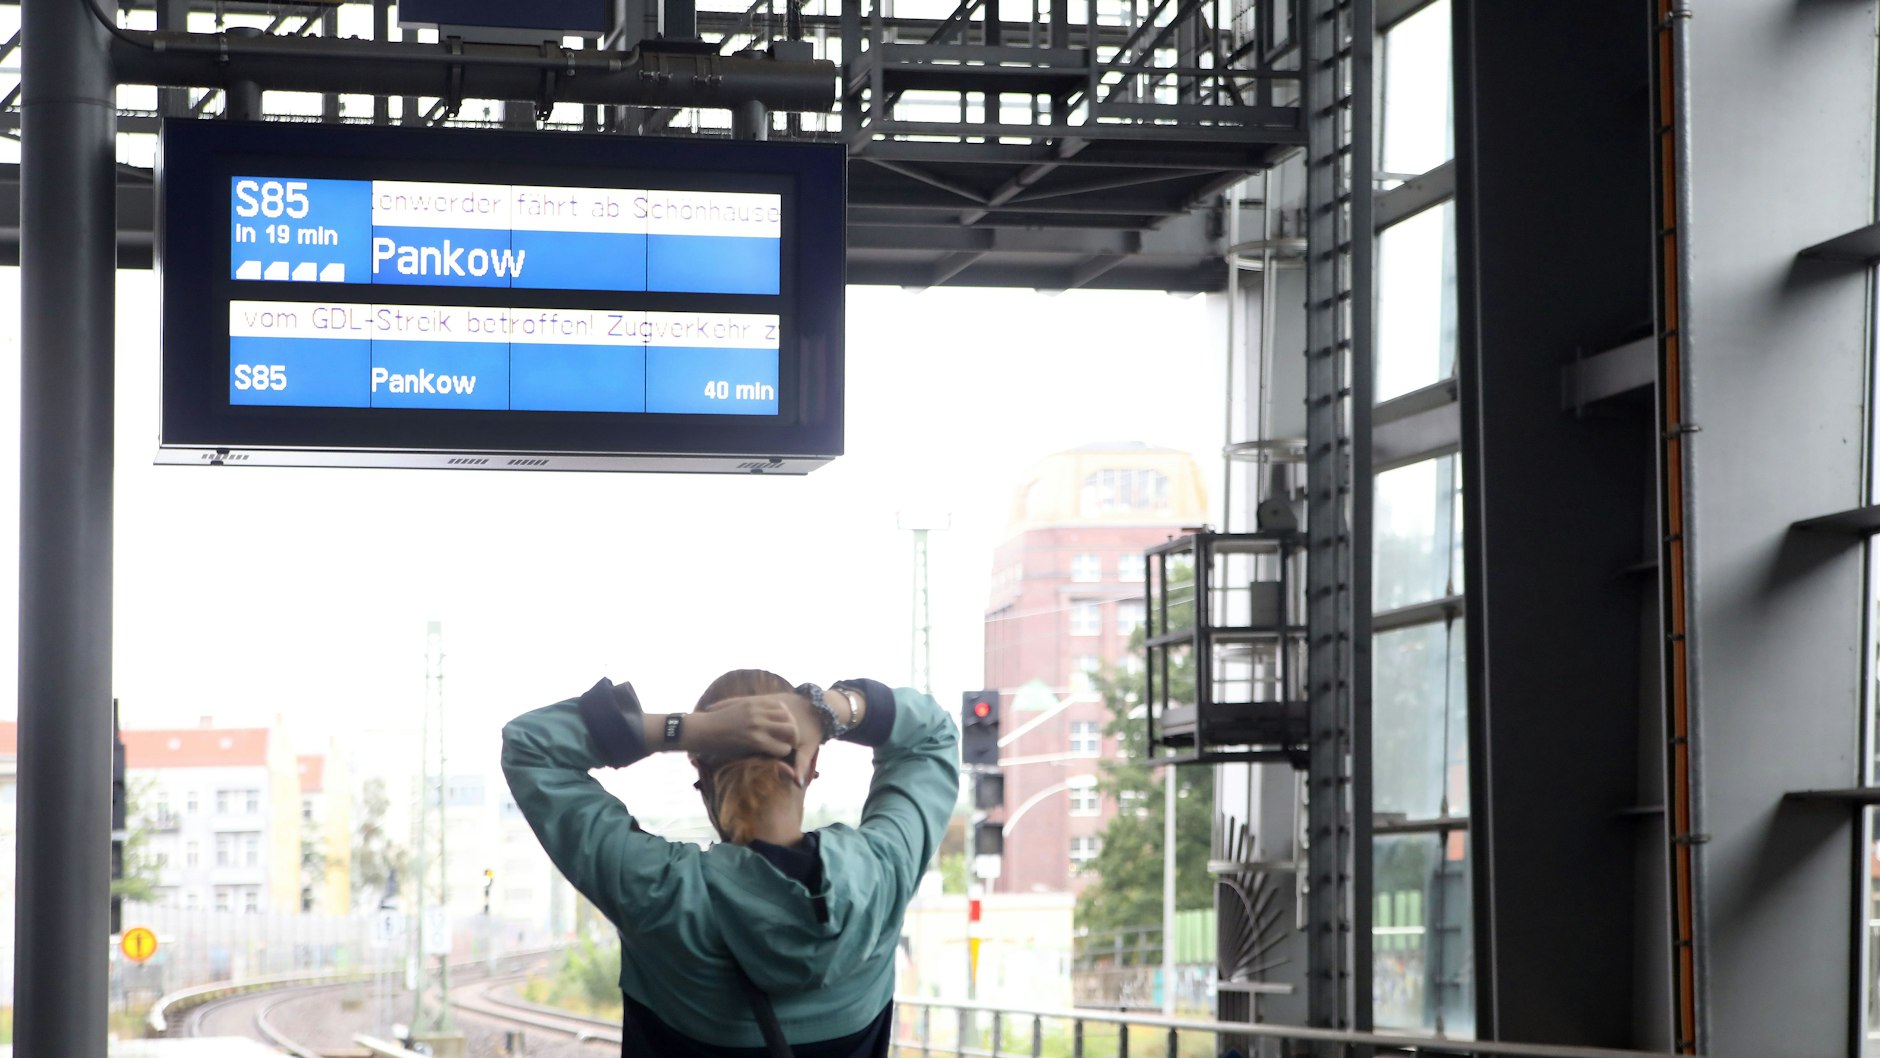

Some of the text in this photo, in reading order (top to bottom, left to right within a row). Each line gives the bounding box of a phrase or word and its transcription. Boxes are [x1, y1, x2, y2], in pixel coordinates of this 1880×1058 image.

[235, 180, 310, 219] S85
[372, 191, 502, 214] enwerder
[518, 193, 578, 217] fährt
[591, 197, 620, 218] ab
[265, 224, 290, 245] 19
[297, 225, 339, 246] min
[372, 237, 526, 278] Pankow
[244, 307, 780, 344] vom GDL-Streik betroffen! Zugverkehr z
[234, 363, 775, 401] S85 Pankow 40 min
